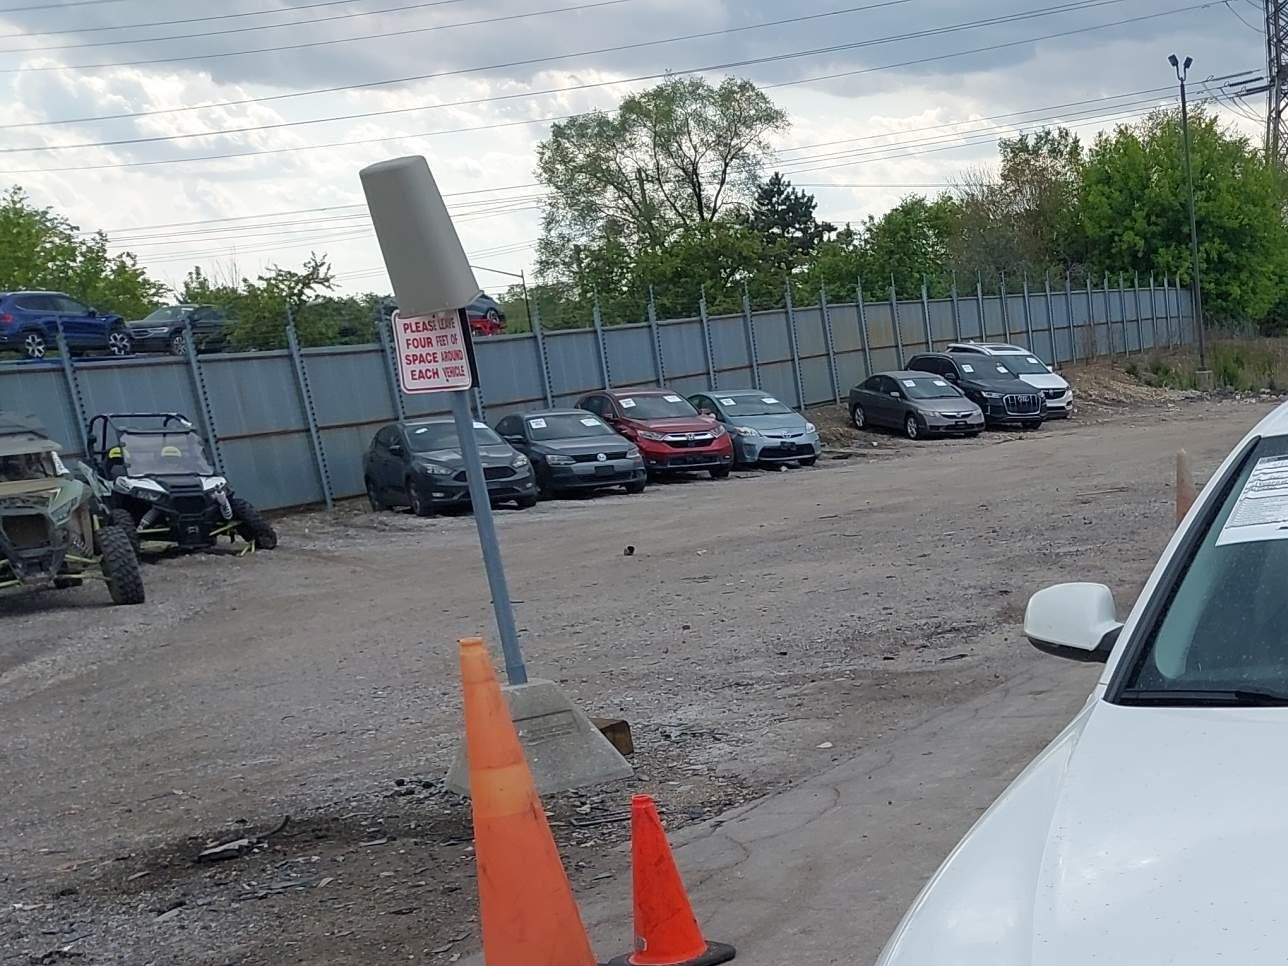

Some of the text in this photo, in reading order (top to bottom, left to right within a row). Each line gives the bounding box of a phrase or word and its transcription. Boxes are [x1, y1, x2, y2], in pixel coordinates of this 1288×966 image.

[403, 317, 455, 334] PLEASE LEAVE
[406, 334, 458, 349] FOUR FEET OF
[405, 350, 463, 365] SPACE AROUND
[411, 366, 465, 380] EACH VEHICLE
